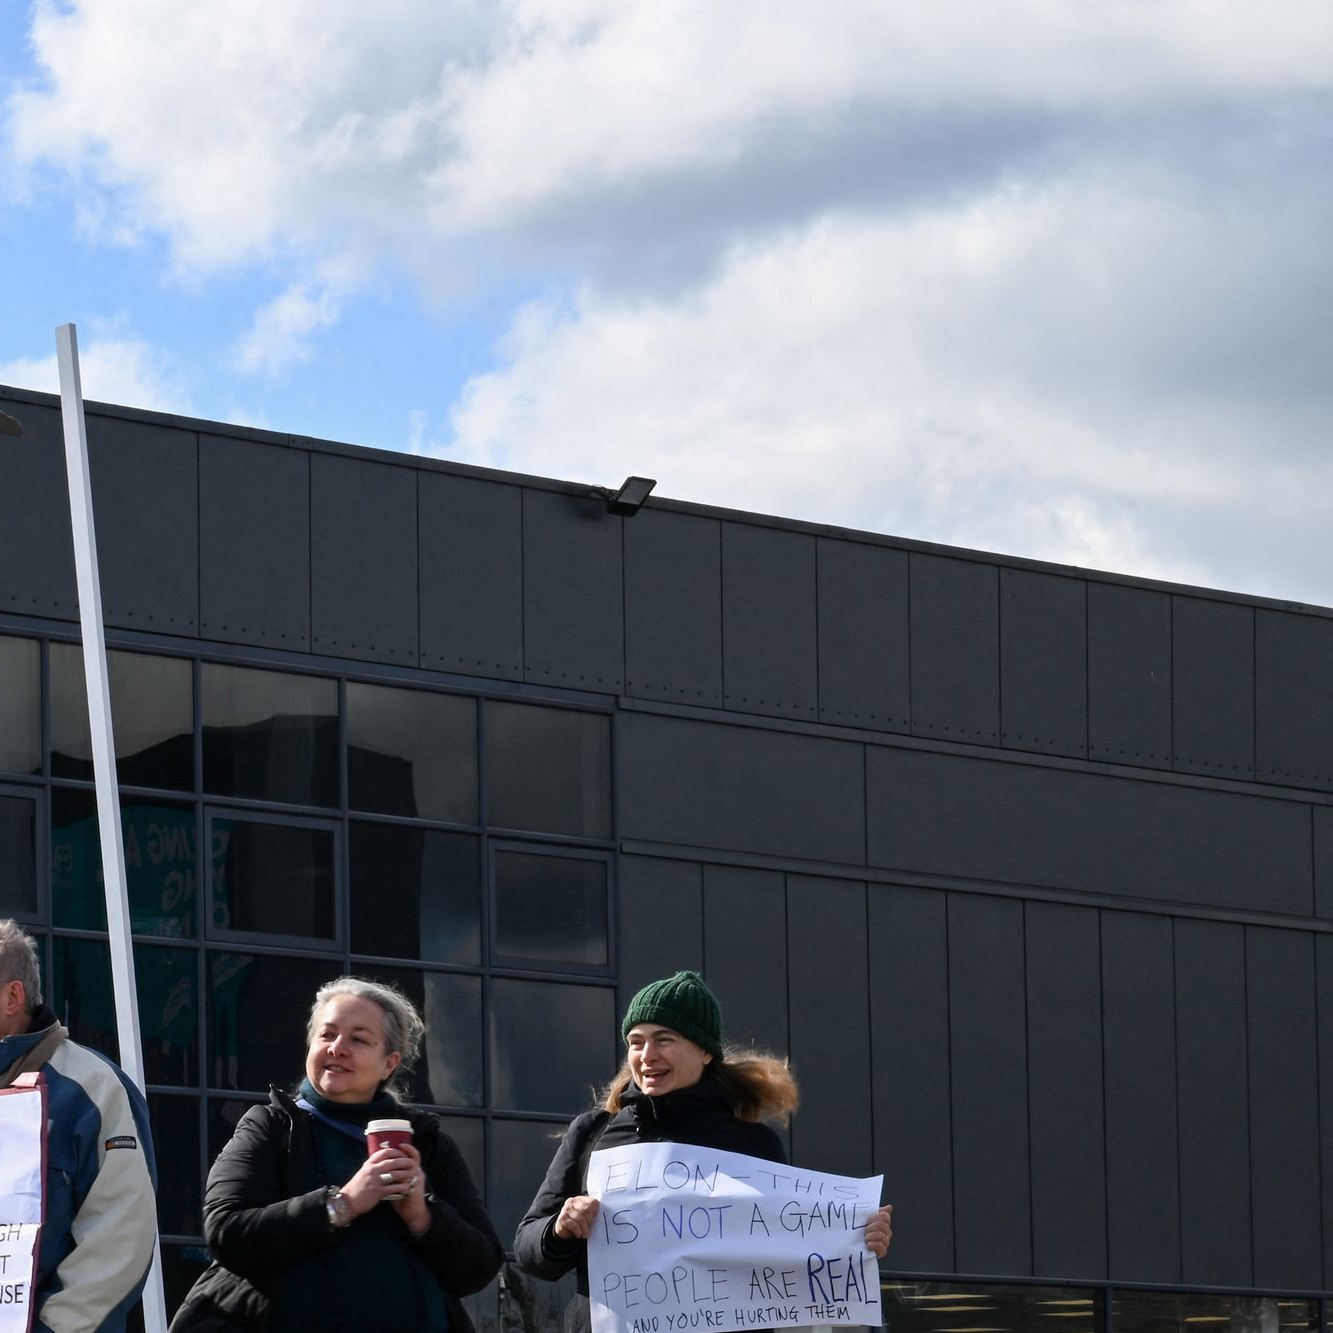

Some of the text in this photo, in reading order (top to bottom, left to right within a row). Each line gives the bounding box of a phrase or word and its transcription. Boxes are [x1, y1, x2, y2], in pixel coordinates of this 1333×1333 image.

[605, 1160, 721, 1193] ELON
[758, 1169, 861, 1200] THIS
[603, 1199, 871, 1245] IS NOT A GAME
[602, 1251, 878, 1314] PEOPLE ARE REAL
[666, 1309, 725, 1331] YOU'RE
[734, 1305, 800, 1326] HURTING
[805, 1303, 851, 1322] THEM
